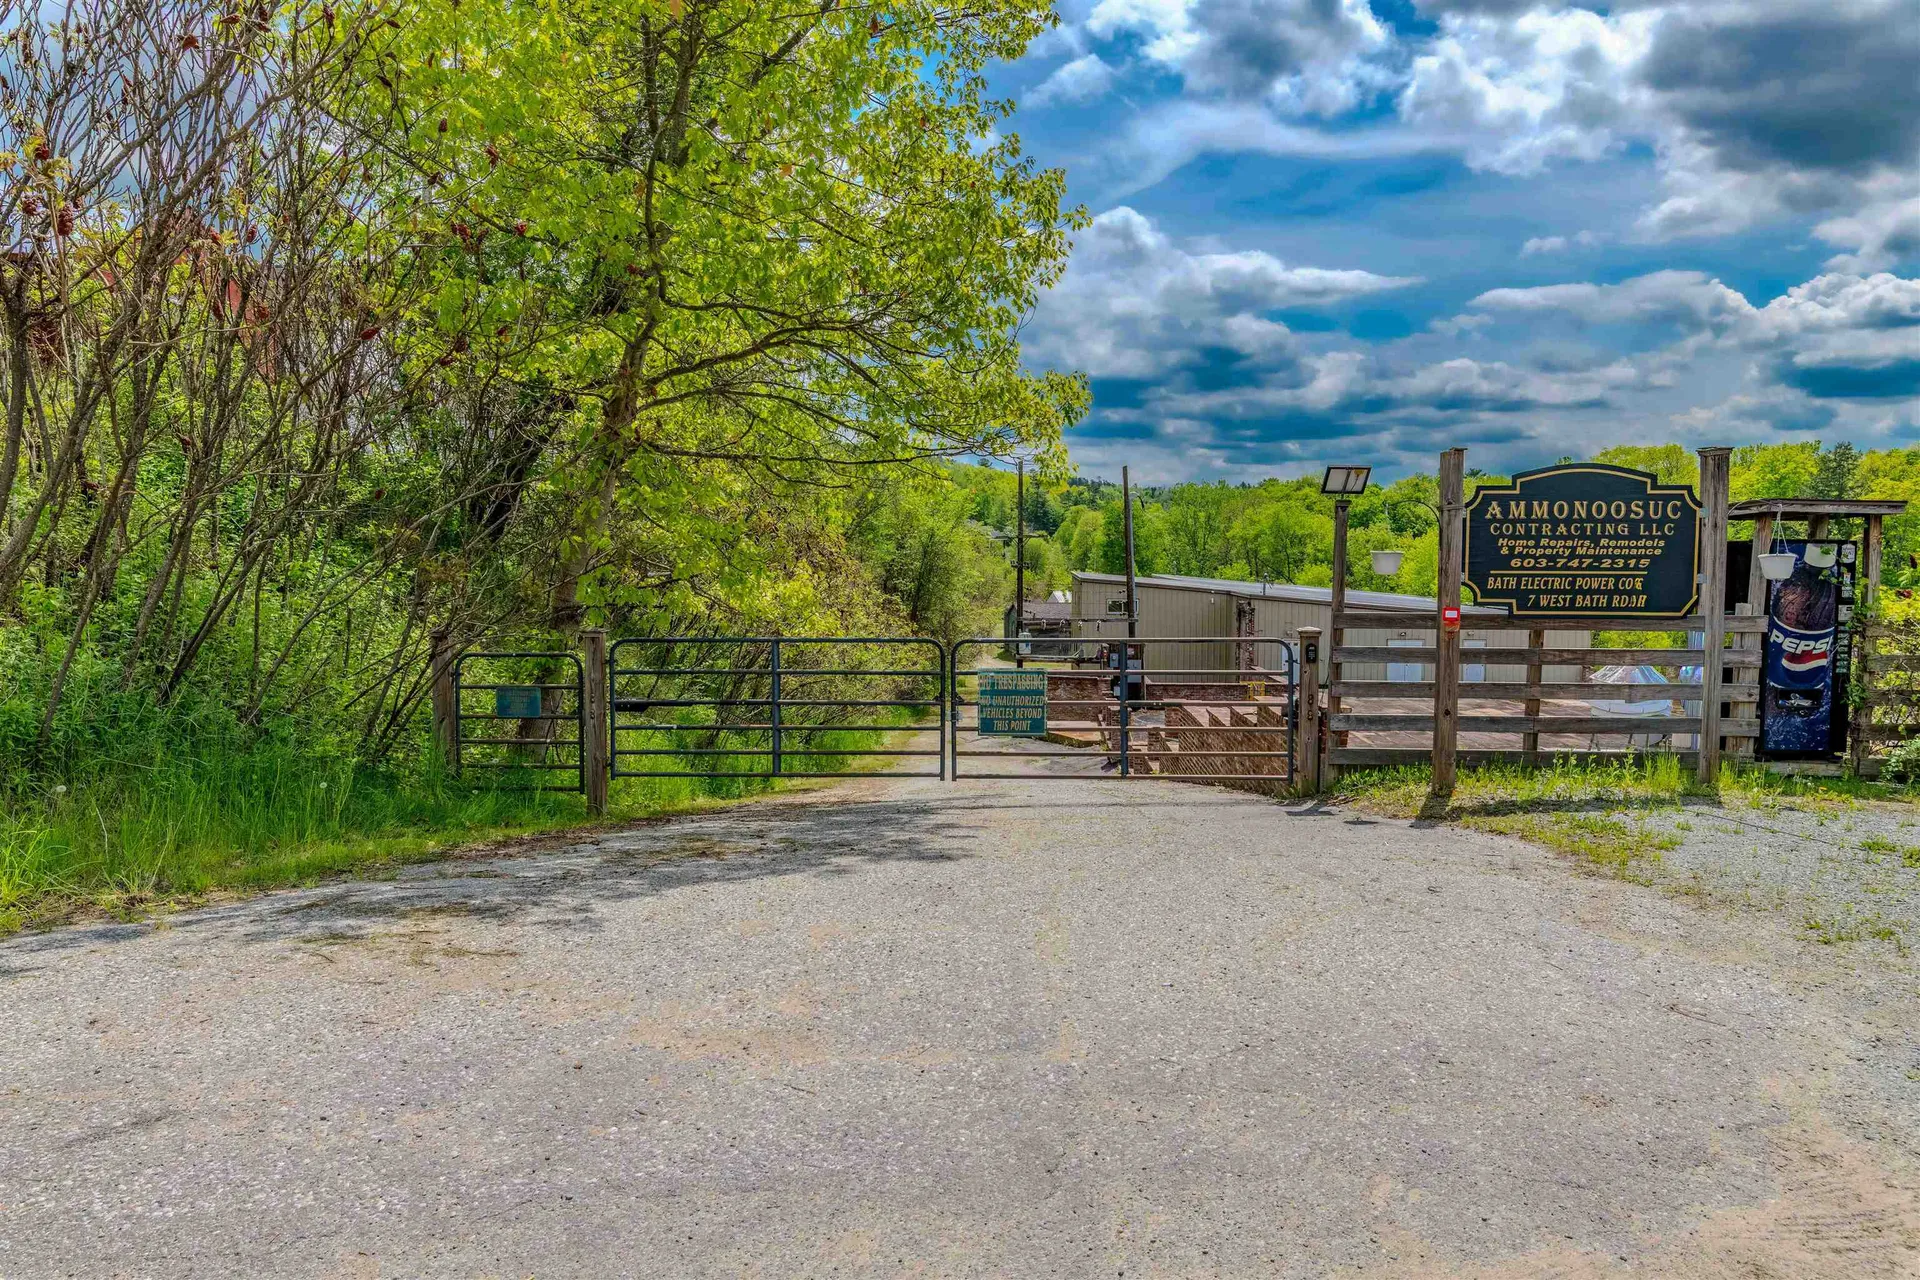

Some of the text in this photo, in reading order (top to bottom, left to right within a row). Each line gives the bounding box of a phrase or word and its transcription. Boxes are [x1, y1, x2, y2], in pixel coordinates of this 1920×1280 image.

[1485, 500, 1682, 520] AMMONOOSUC
[1490, 523, 1675, 536] CONTRACTING LLC
[1498, 538, 1665, 548] Home Repairs, Remodels
[1500, 546, 1662, 556] & Property Maintenance
[1510, 558, 1650, 568] 603-747-2315
[1487, 577, 1517, 589] BATH
[1520, 577, 1572, 590] ELECTRIC
[1575, 577, 1614, 590] POWER
[1527, 595, 1535, 607] 7
[1540, 595, 1572, 607] WEST
[1575, 595, 1608, 607] BATH
[1770, 628, 1833, 654] PEPSI
[993, 674, 1044, 690] TRESPASSING
[993, 696, 1045, 706] UNAUTHORIZED
[983, 708, 1042, 718] VEHICLES BEYOND
[994, 721, 1032, 730] THIS POINT
